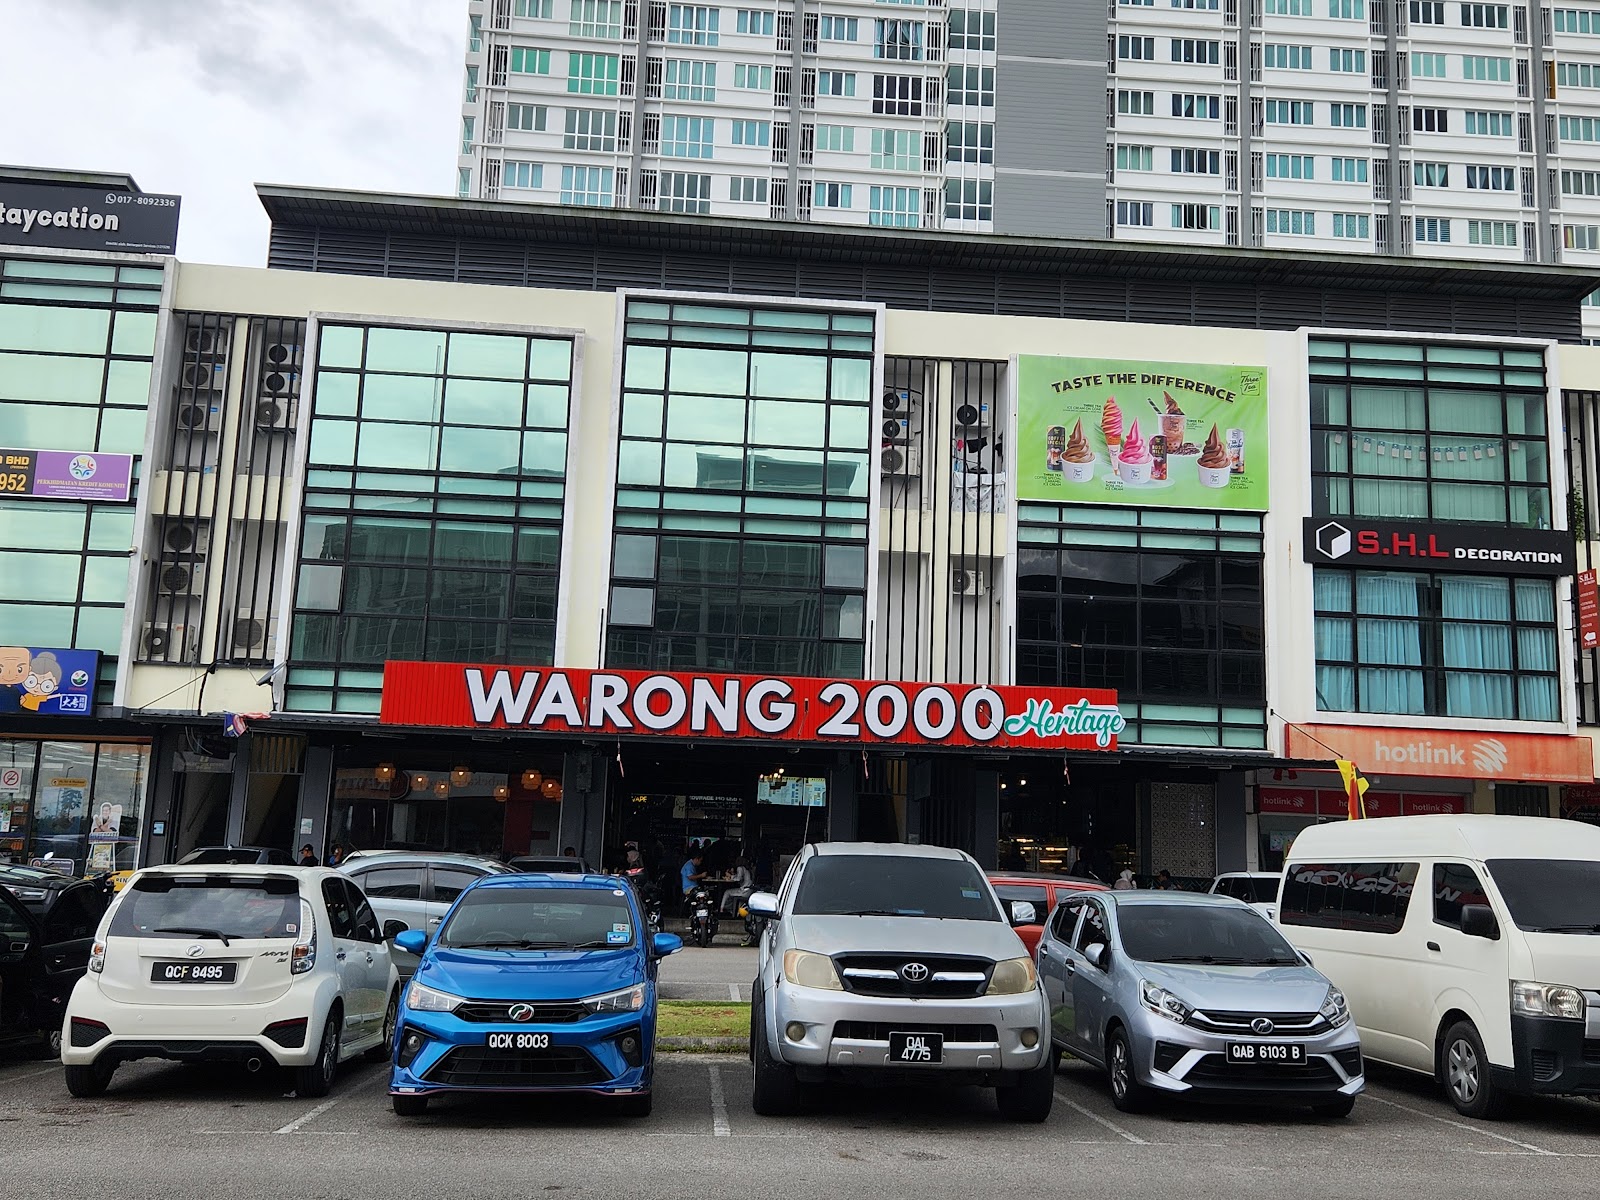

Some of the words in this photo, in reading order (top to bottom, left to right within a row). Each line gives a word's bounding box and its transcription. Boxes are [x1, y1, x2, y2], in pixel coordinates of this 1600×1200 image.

[117, 196, 176, 207] 017-8092336
[1051, 375, 1102, 393] TASTE
[1106, 374, 1136, 384] THE
[1141, 374, 1236, 403] DIFFERENCE
[6, 455, 30, 465] BHD
[1358, 530, 1449, 558] S.H.L
[1454, 548, 1563, 563] DECORATION
[464, 668, 798, 734] WARONG
[816, 681, 1006, 742] 2000
[1004, 698, 1126, 748] Heritage
[1375, 740, 1465, 765] hotlink
[1263, 796, 1291, 806] hotlink
[1412, 802, 1440, 813] hotlink
[165, 965, 189, 978] QCF
[191, 965, 223, 978] 8495
[489, 1035, 513, 1048] QCK
[516, 1034, 549, 1048] 8003
[901, 1048, 931, 1061] 4775
[1233, 1046, 1254, 1058] QAB
[1260, 1046, 1287, 1058] 6103
[1292, 1047, 1300, 1059] B
